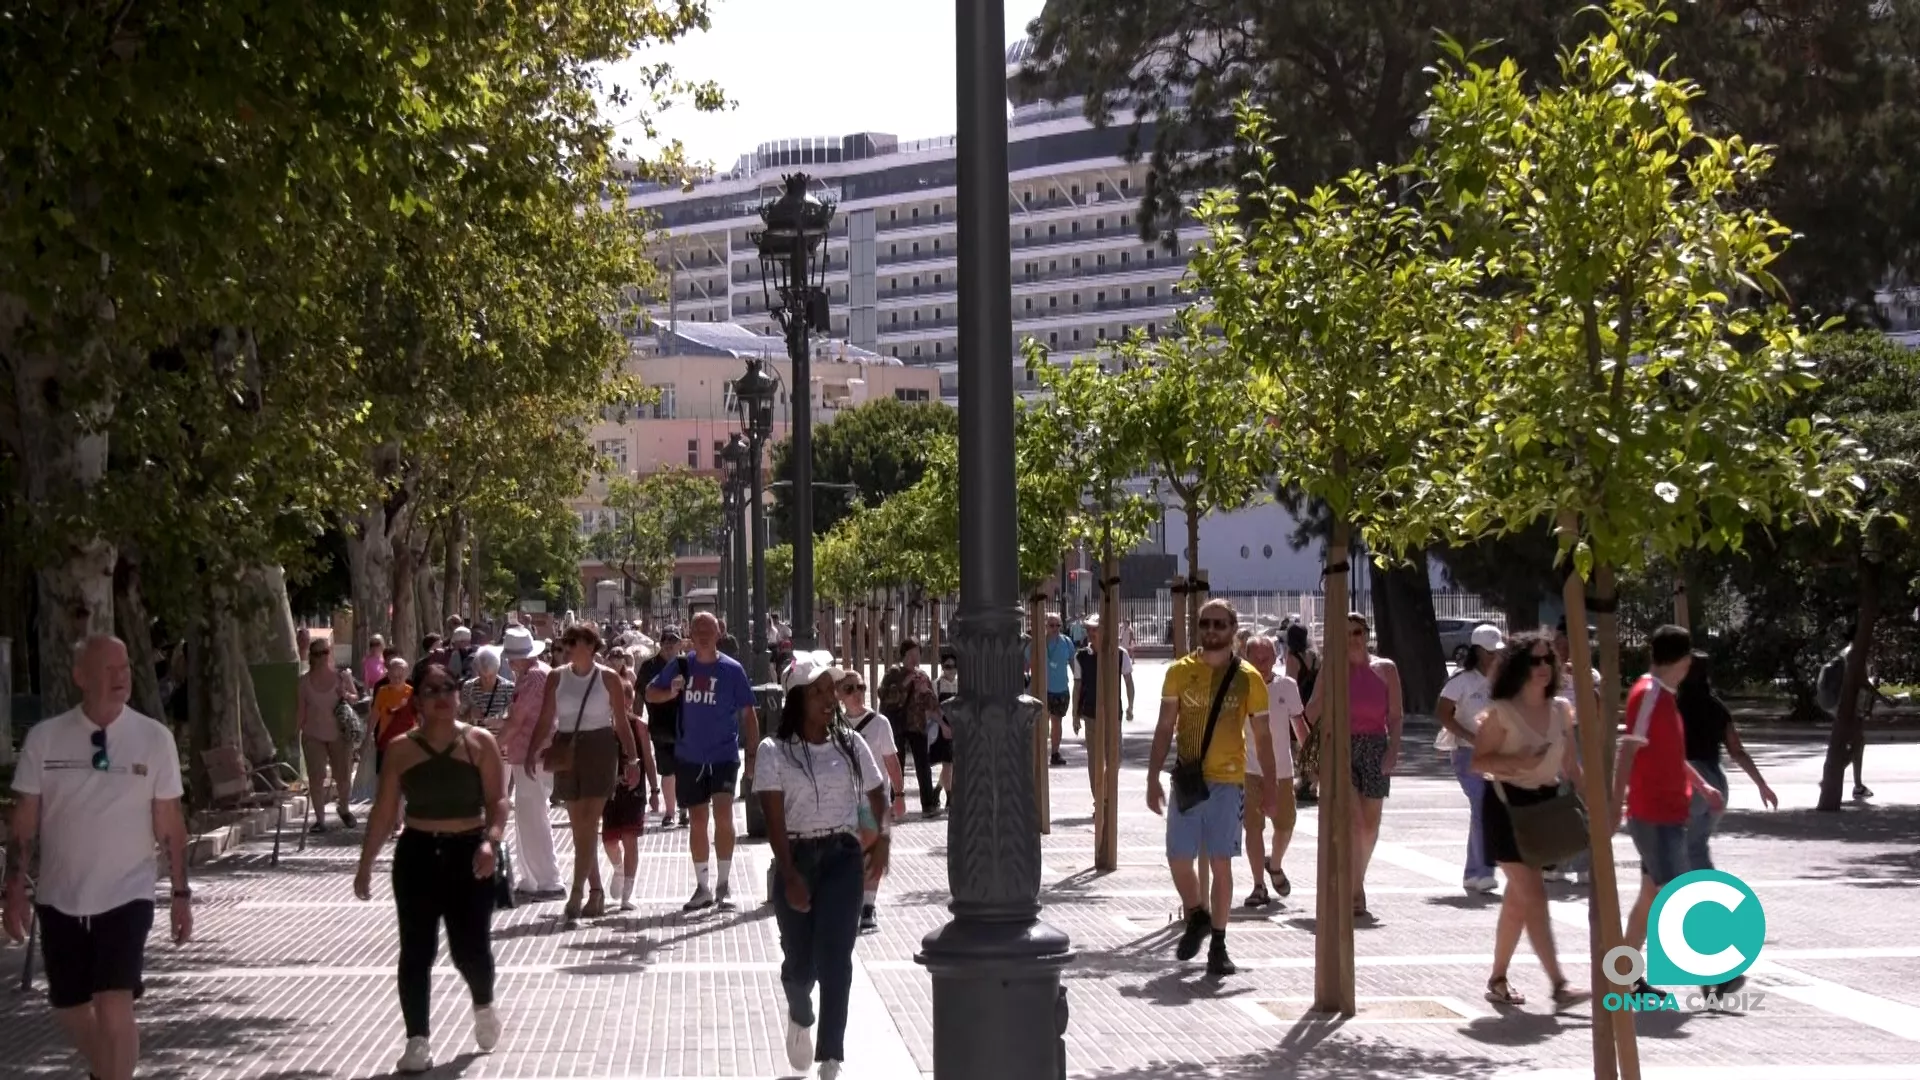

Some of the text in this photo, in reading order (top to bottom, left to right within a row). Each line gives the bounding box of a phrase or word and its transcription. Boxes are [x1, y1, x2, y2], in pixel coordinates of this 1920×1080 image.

[686, 676, 718, 691] JT
[685, 690, 717, 705] DO IT.
